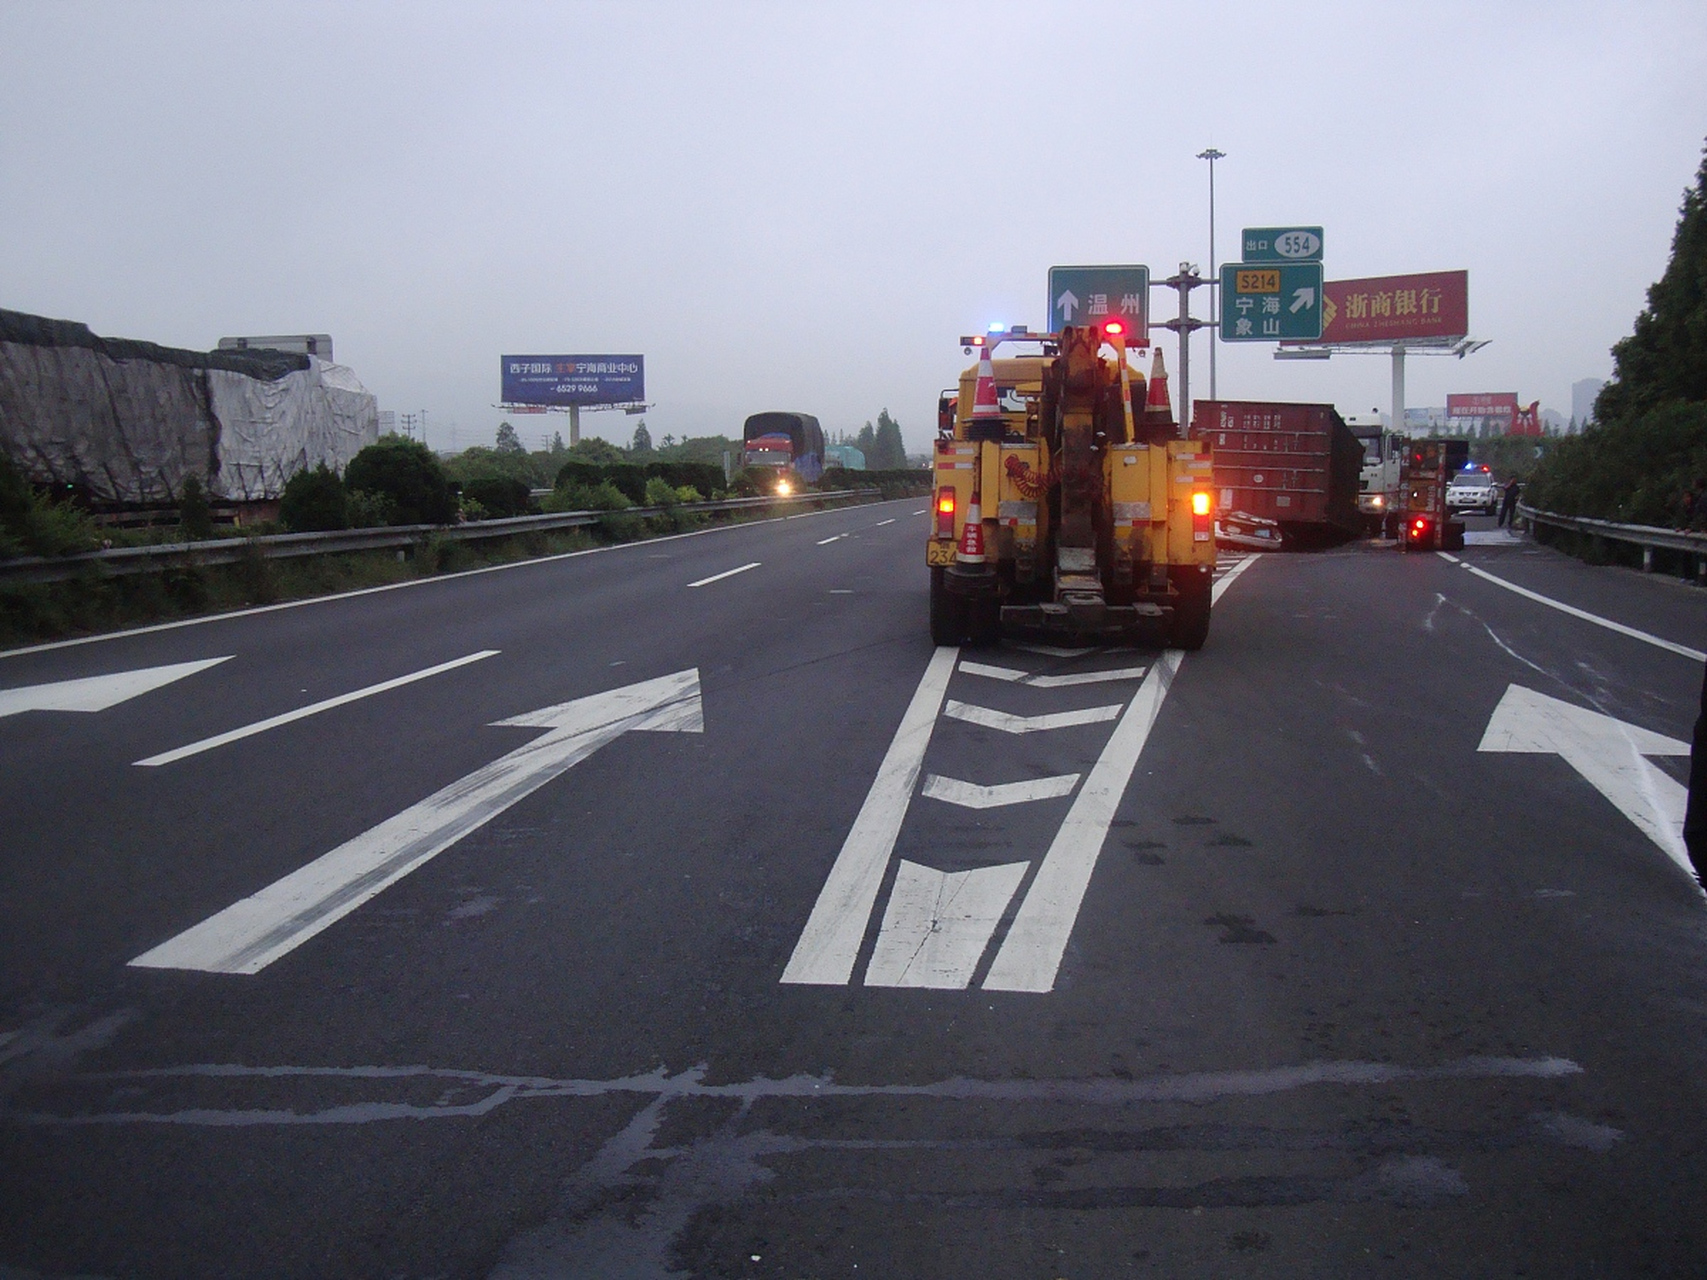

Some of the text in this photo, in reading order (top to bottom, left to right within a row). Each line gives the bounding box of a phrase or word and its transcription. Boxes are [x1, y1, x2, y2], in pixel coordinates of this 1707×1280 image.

[1246, 236, 1311, 254] 出口 554
[1241, 274, 1276, 290] S214
[1088, 294, 1140, 316] 温州
[1235, 297, 1281, 313] 宁海
[1345, 288, 1442, 318] 浙商银行
[1235, 318, 1280, 336] 象山
[1345, 317, 1442, 330] CHINA ZHESHANG BANK
[556, 385, 598, 393] 6529 9666
